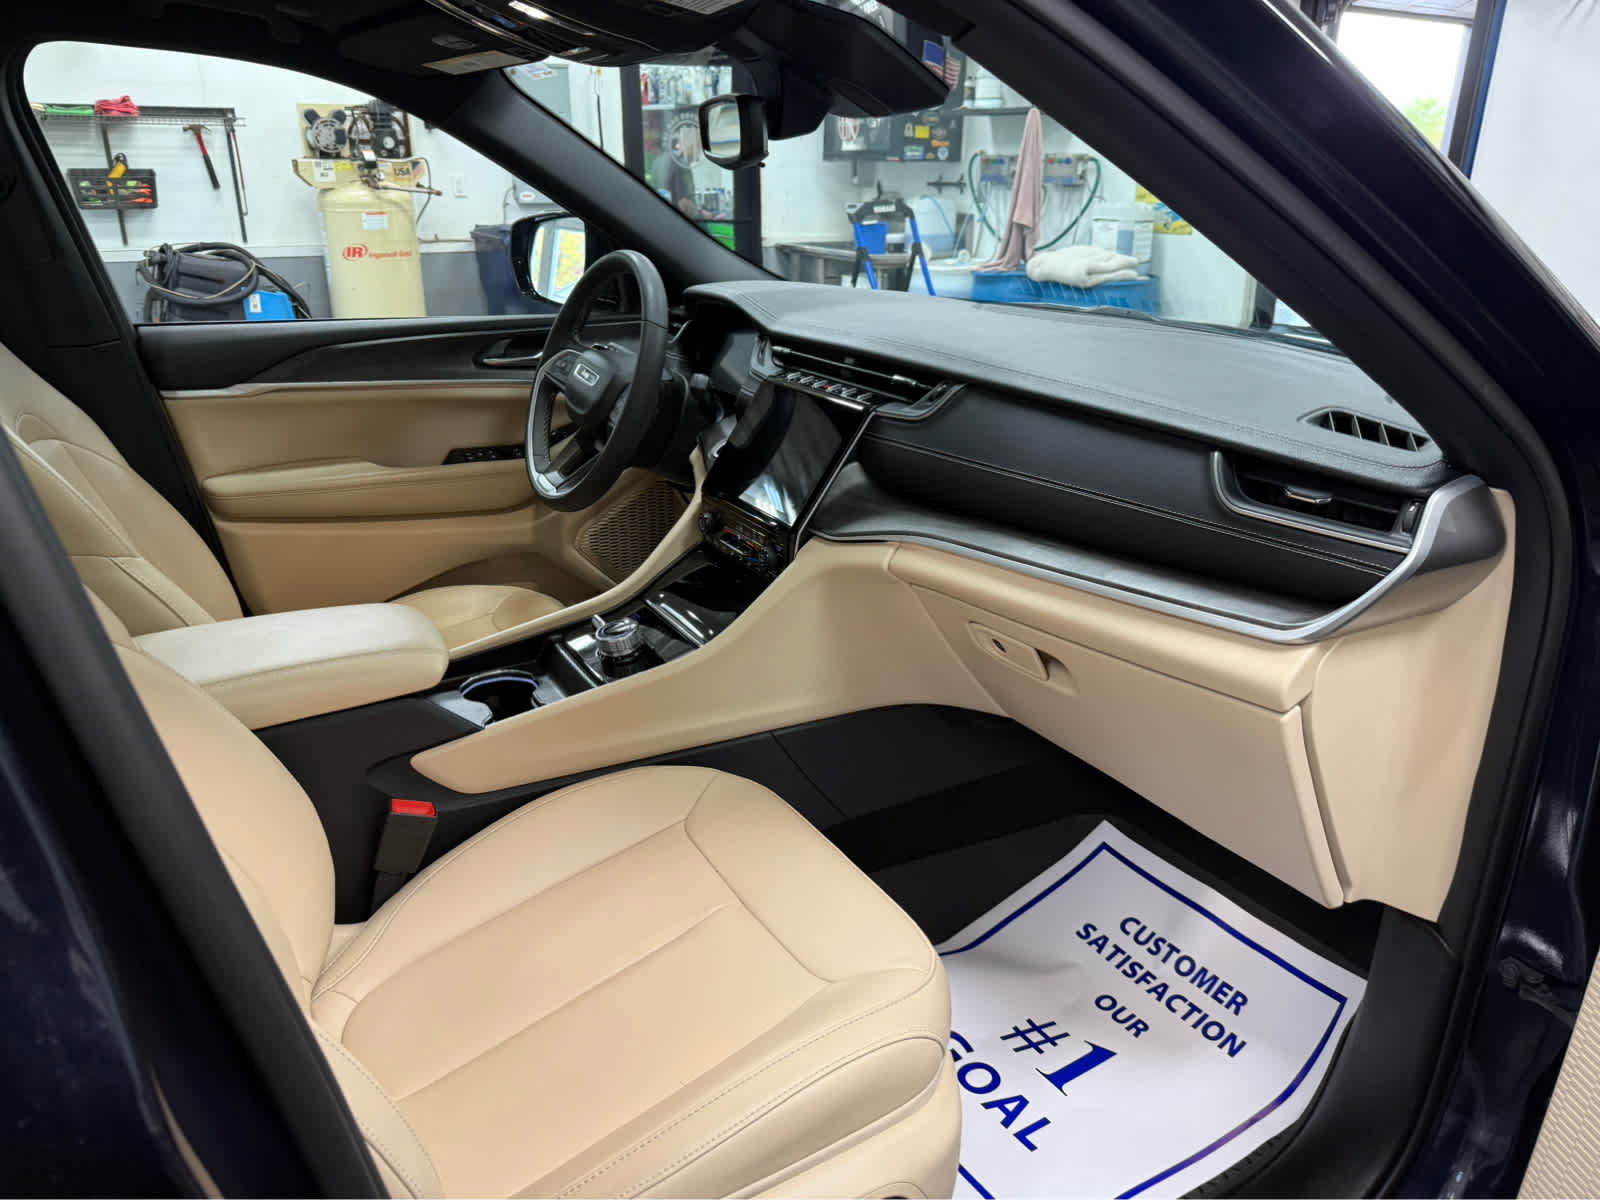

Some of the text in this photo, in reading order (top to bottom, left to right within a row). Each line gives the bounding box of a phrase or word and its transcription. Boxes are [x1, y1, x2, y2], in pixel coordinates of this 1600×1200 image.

[1074, 922, 1248, 1058] SATISFACTION
[1119, 916, 1249, 1017] CUSTOMER
[1000, 1018, 1118, 1097] #1
[1094, 994, 1150, 1039] OUR
